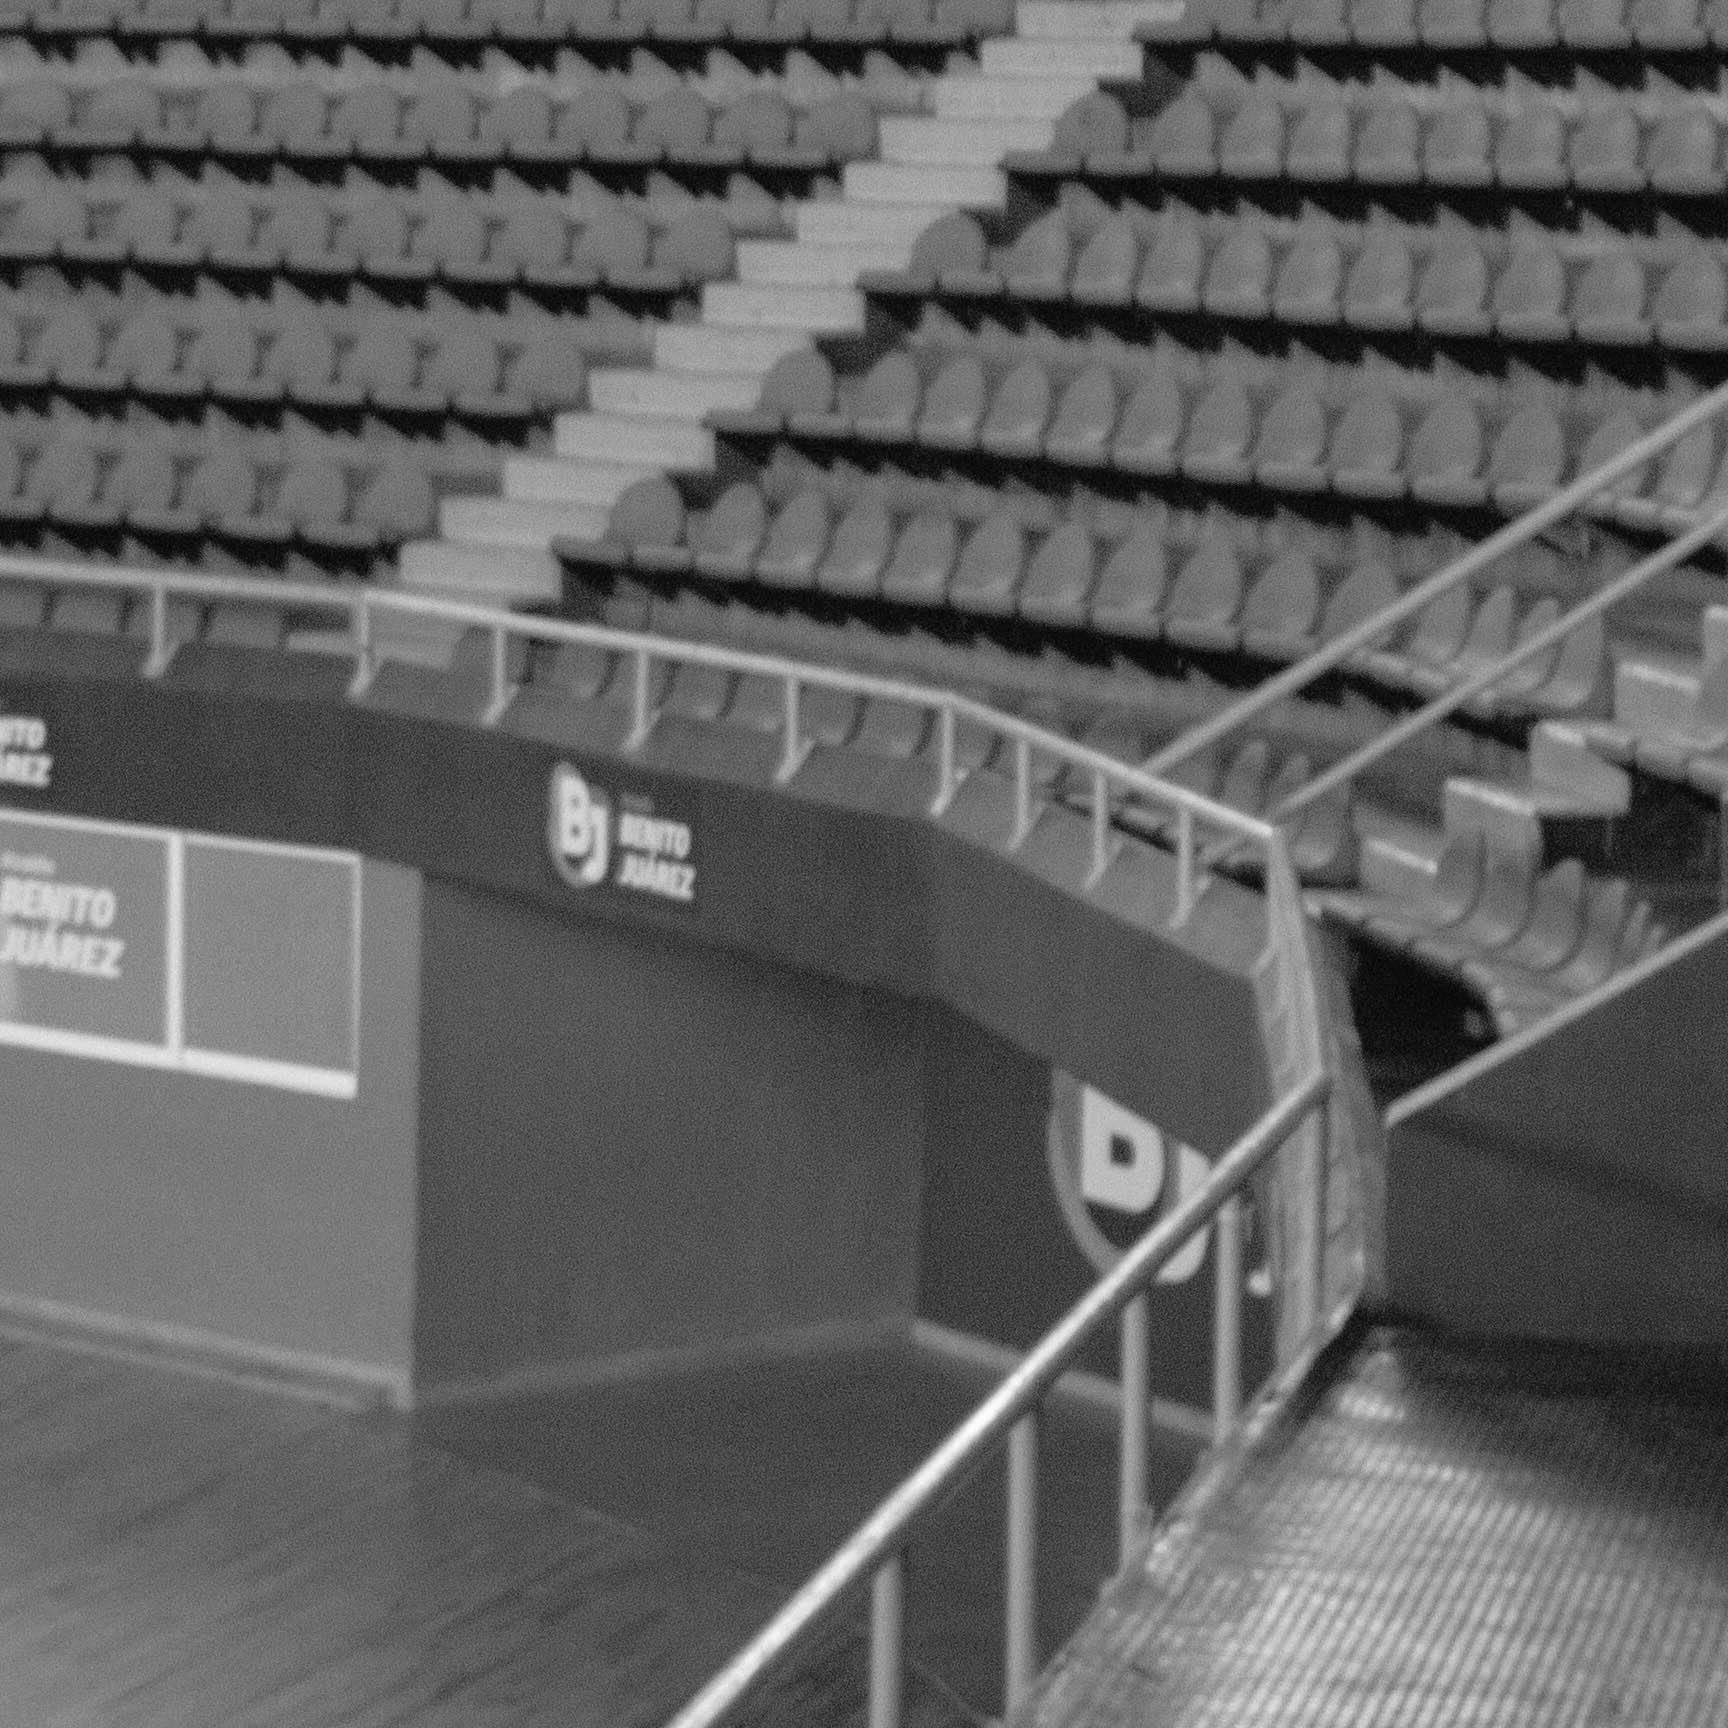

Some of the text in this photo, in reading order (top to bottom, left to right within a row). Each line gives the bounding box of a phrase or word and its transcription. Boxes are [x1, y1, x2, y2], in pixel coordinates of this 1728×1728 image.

[560, 775, 609, 882] BJ
[620, 812, 691, 860] BENITO
[0, 875, 117, 929] BENITO
